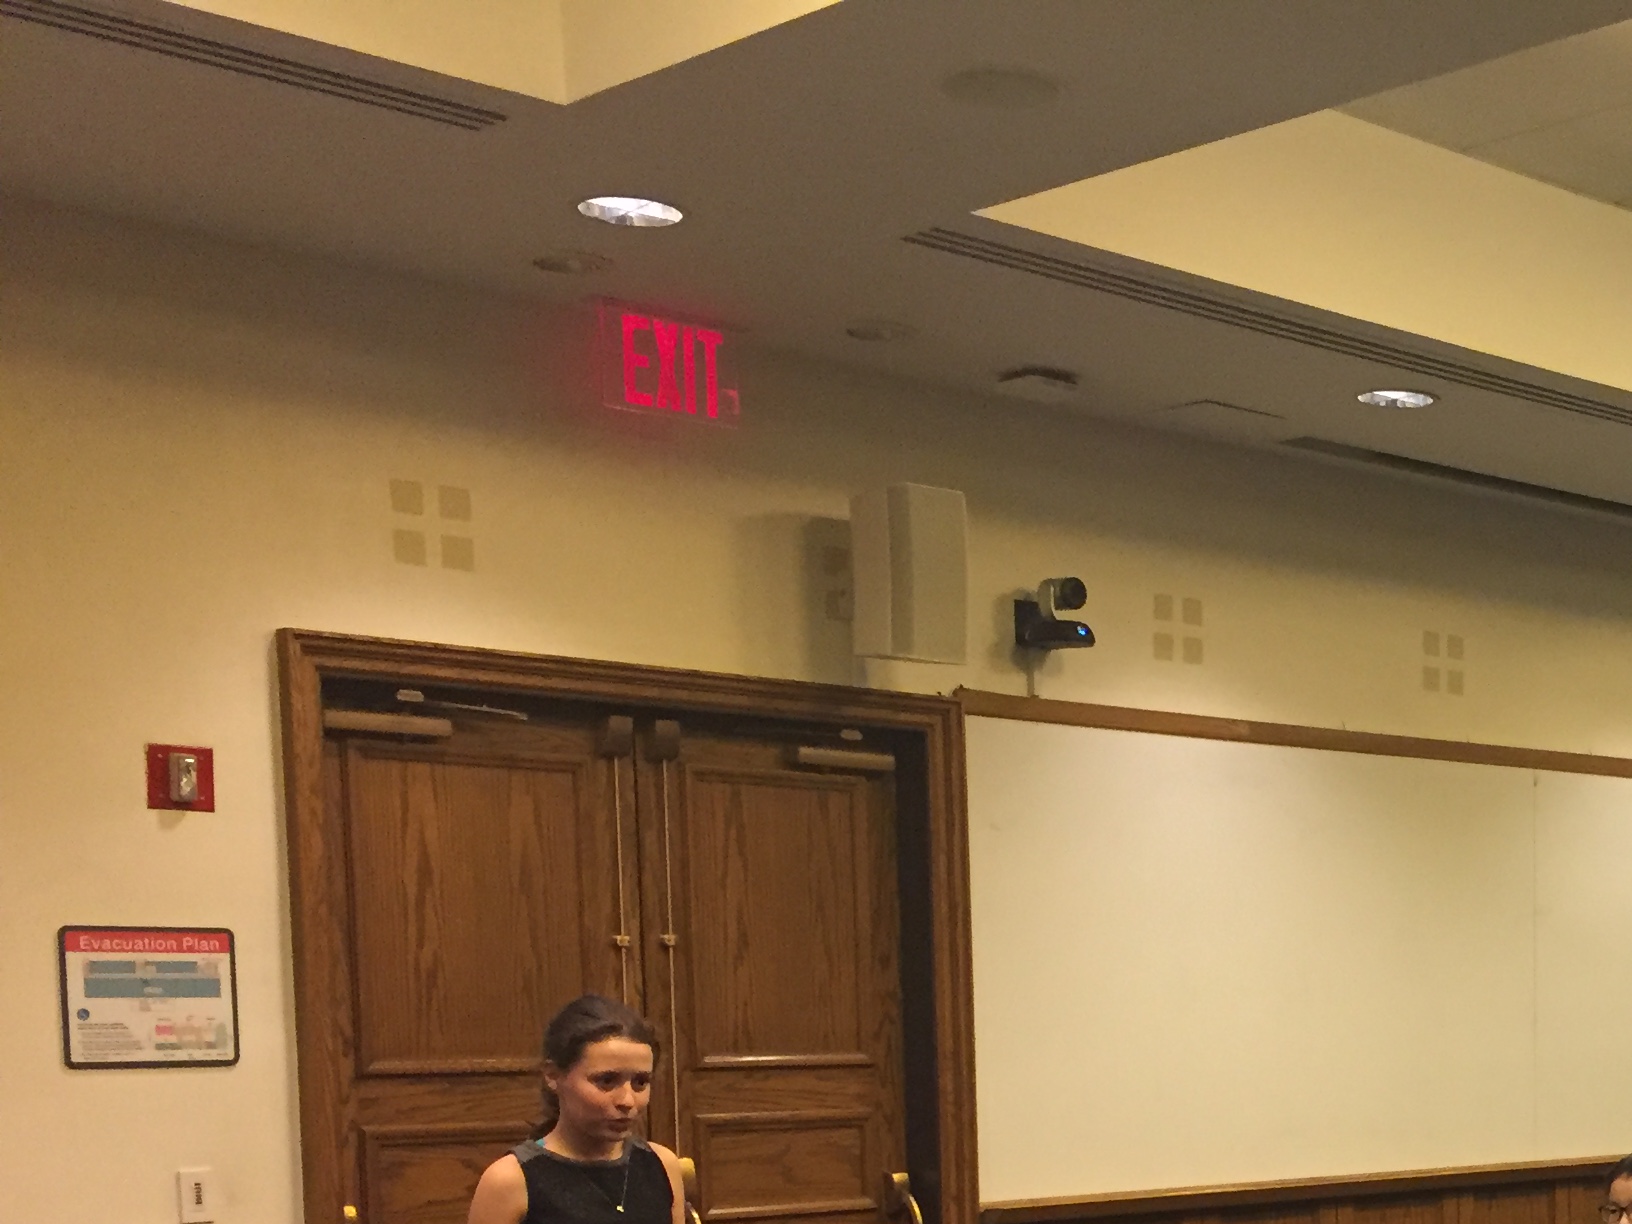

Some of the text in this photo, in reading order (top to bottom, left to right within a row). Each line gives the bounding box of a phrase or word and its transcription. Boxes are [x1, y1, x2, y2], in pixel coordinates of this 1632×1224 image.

[621, 314, 724, 419] EXIT
[79, 935, 220, 951] Evacuation Plan
